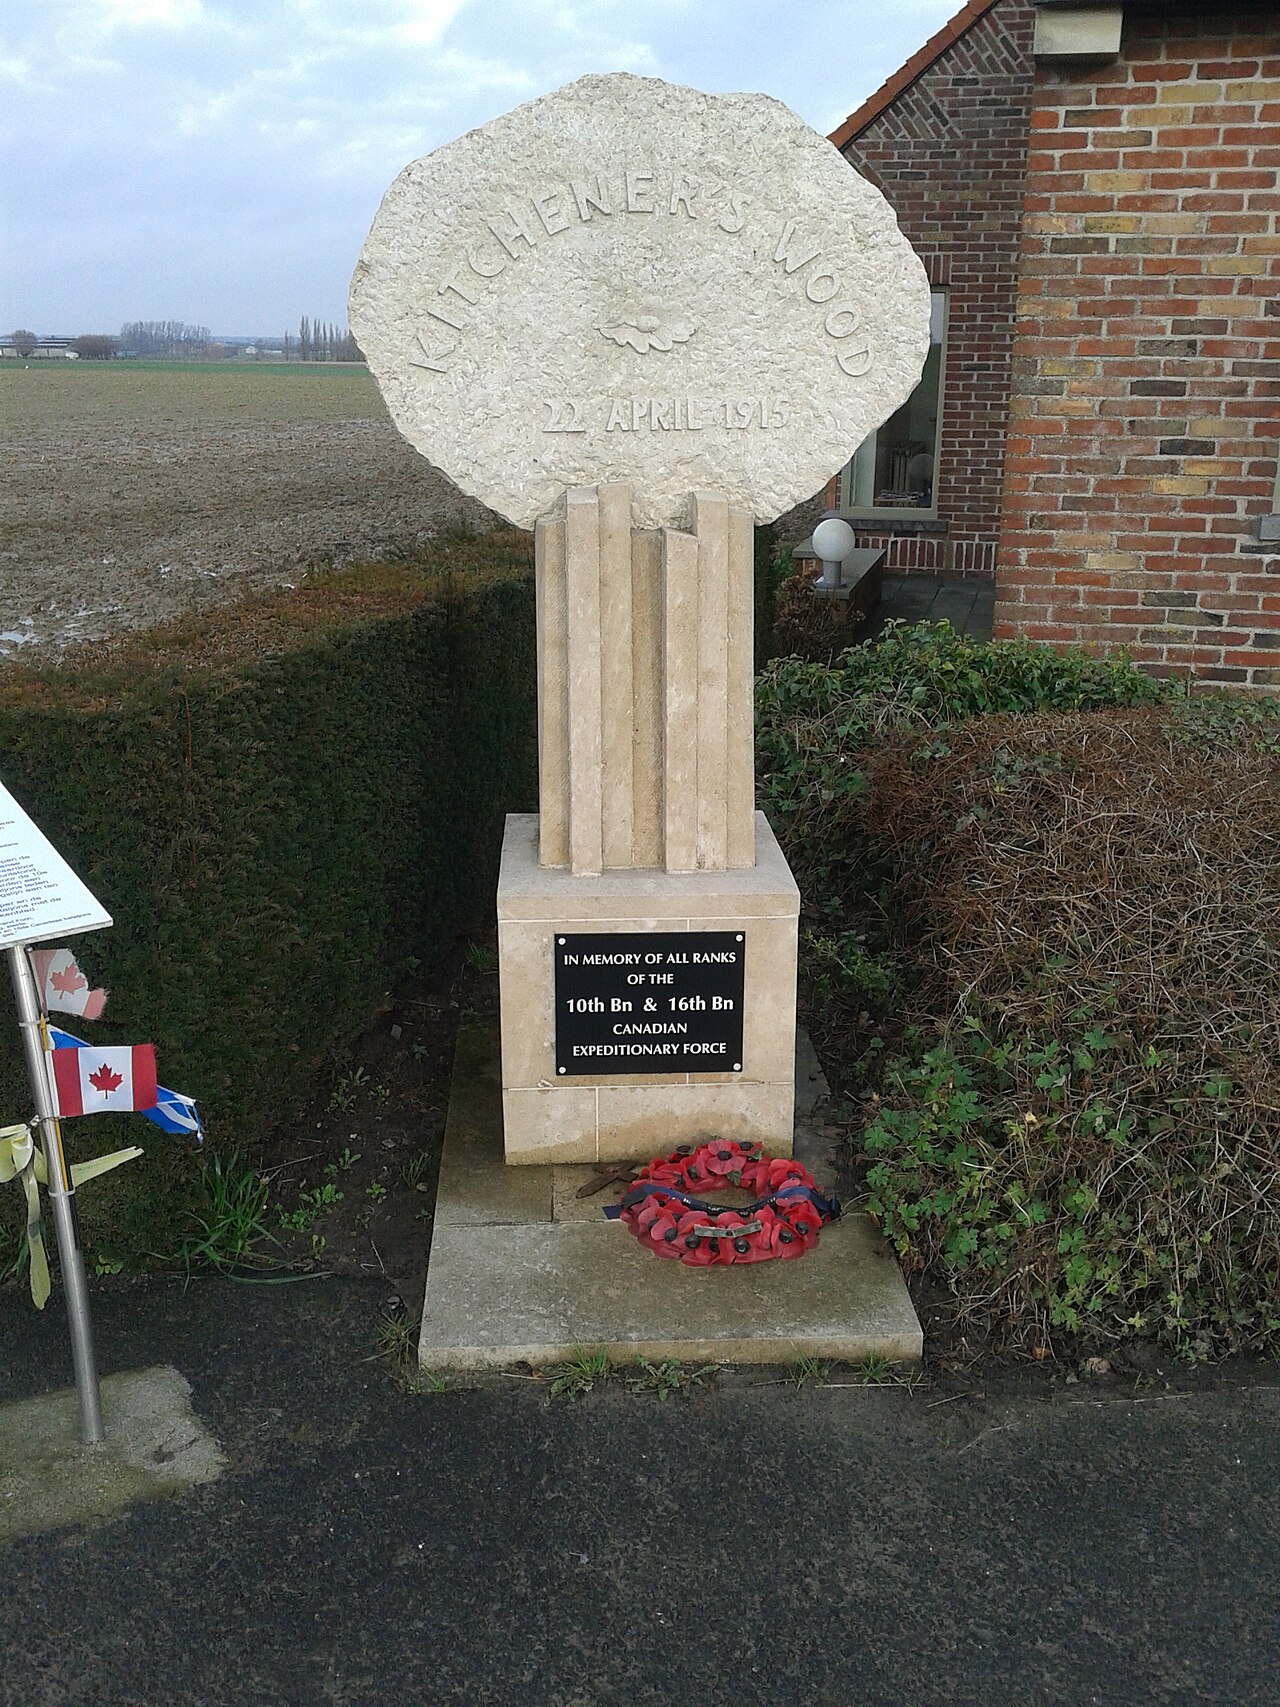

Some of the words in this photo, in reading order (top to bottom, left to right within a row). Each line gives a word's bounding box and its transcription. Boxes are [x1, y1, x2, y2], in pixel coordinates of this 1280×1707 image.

[408, 169, 752, 374] KITCHENER'S
[772, 218, 875, 378] WOOD
[542, 401, 586, 433] 22
[605, 398, 703, 432] APRIL
[721, 398, 790, 430] 1915
[563, 954, 579, 966] IN
[582, 953, 641, 965] MEMORY
[644, 953, 663, 964] OF
[666, 952, 689, 964] ALL
[692, 951, 737, 963] RANKS
[627, 973, 645, 985] OF
[649, 973, 674, 985] THE
[566, 996, 605, 1013] 10th
[610, 997, 633, 1012] Bn
[643, 997, 658, 1012] &
[668, 995, 706, 1011] 16th
[712, 996, 734, 1011] Bn
[612, 1022, 688, 1035] CANADIAN
[572, 1043, 680, 1057] EXPEDITIONARY
[683, 1042, 727, 1055] FORCE
